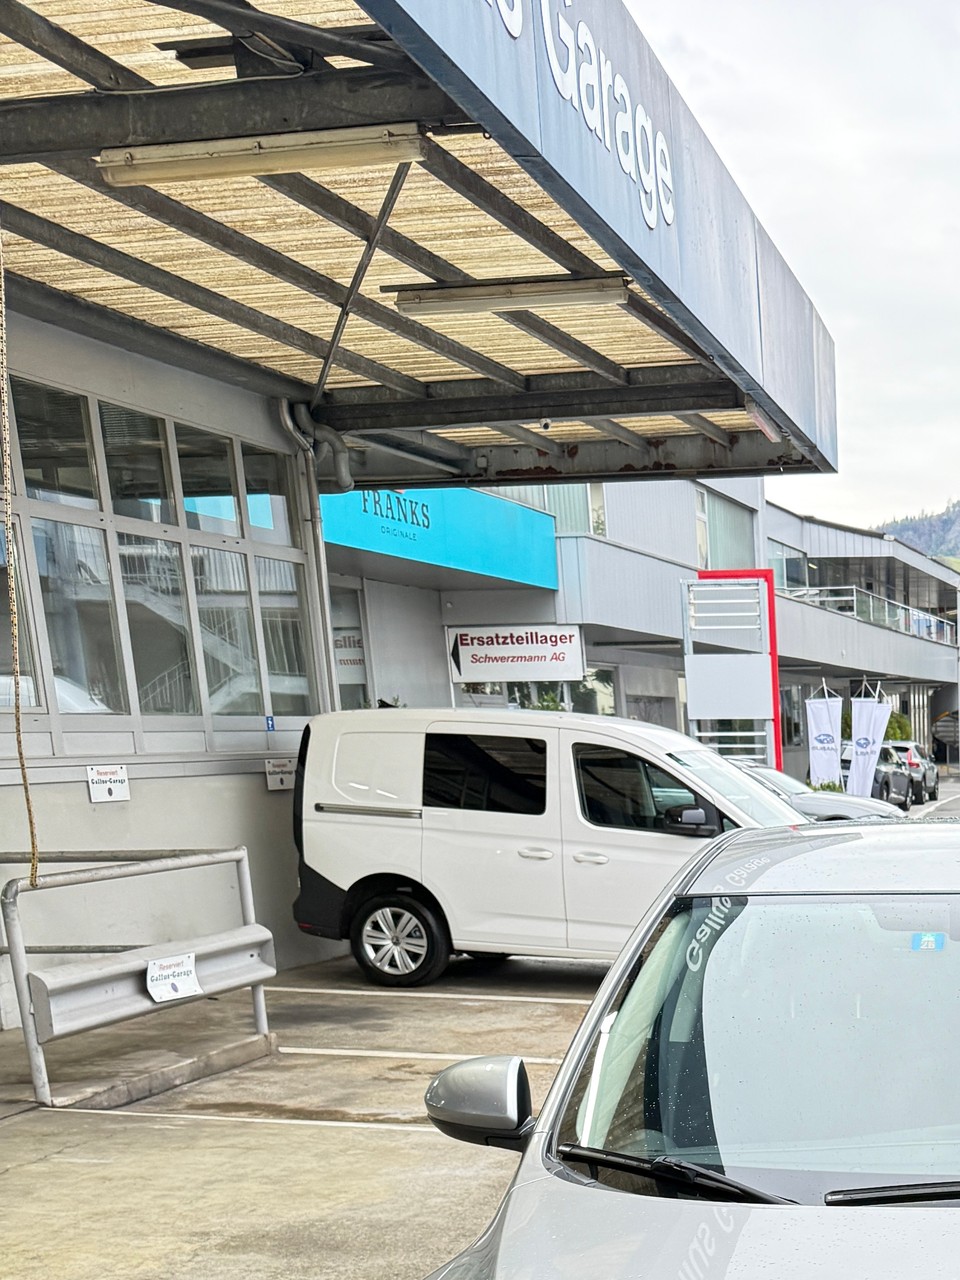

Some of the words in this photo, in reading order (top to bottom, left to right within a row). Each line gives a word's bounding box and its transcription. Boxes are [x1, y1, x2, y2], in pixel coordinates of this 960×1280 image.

[541, 0, 675, 229] Garage
[361, 490, 431, 529] FRANKS
[380, 525, 417, 541] ORIGINALE
[459, 631, 575, 647] Ersatzteillager
[470, 653, 547, 664] Schwerzmann
[549, 652, 566, 662] AG
